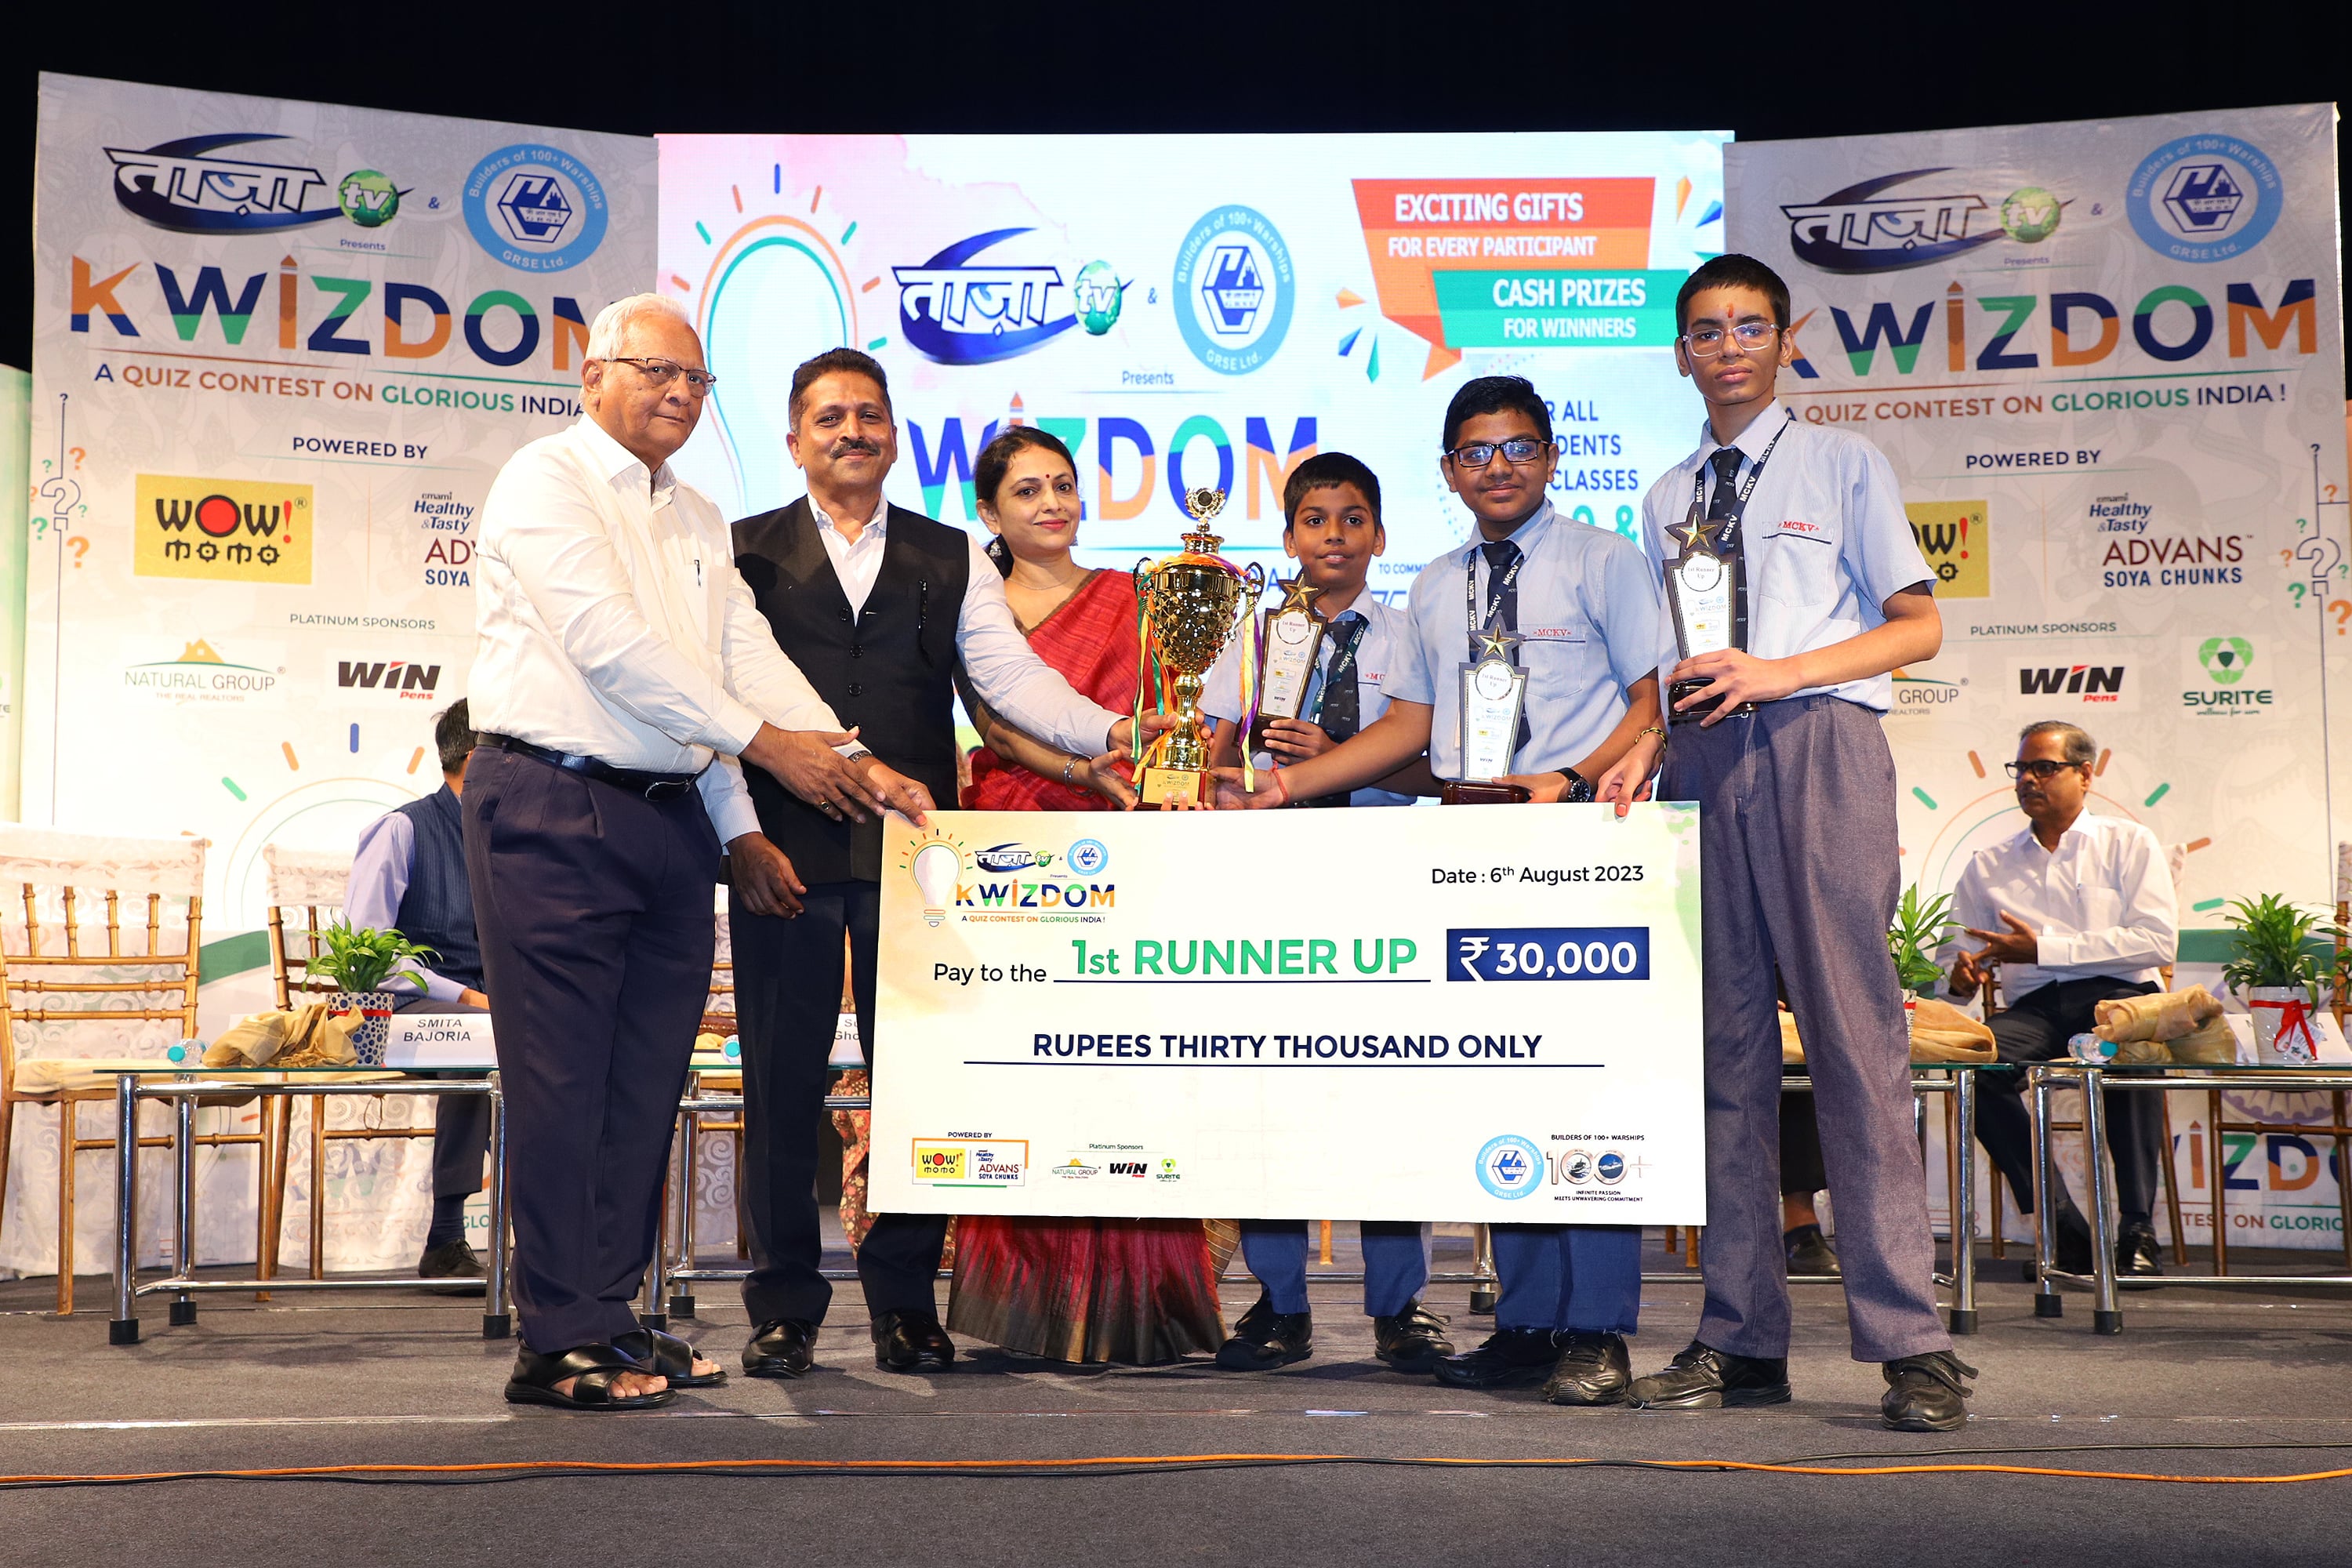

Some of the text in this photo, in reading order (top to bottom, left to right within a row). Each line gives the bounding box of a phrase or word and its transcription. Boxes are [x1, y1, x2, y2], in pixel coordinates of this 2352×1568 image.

[469, 150, 603, 209] Builders of 100+ Warships
[343, 181, 391, 211] tv
[428, 196, 440, 209] &
[1395, 192, 1584, 223] EXCITING GIFTS
[2006, 198, 2053, 227] tv
[2090, 203, 2103, 216] &
[339, 239, 386, 252] Presents
[1178, 227, 1211, 283] Builders
[1214, 214, 1225, 230] of
[1388, 236, 1597, 257] FOR EVERY PARTICIPANT
[2170, 244, 2209, 259] GRSE
[503, 250, 539, 269] GRSE
[2004, 255, 2049, 267] Presents
[1076, 278, 1117, 314] tv
[1147, 288, 1157, 304] &
[1492, 278, 1646, 307] CASH PRIZES
[1504, 318, 1636, 338] FOR WINNNERS
[1206, 350, 1237, 371] GRSE
[1122, 371, 1174, 385] Presents
[95, 364, 114, 383] A
[123, 365, 191, 388] QUIZ
[199, 371, 325, 397] CONTEST
[333, 382, 373, 401] ON
[382, 385, 514, 412] GLORIOUS
[1563, 400, 1599, 422] ALL
[1805, 404, 1867, 425] QUIZ
[1875, 397, 1995, 419] CONTEST
[2003, 395, 2042, 414] ON
[2052, 388, 2190, 412] GLORIOUS
[2198, 384, 2273, 406] INDIA
[293, 437, 428, 459] POWERED BY
[1555, 434, 1621, 456] DENTS
[1966, 450, 2101, 469] POWERED BY
[1551, 469, 1639, 491] CLASSES
[1740, 476, 1757, 502] MCKV
[422, 491, 452, 501] emami
[414, 500, 474, 519] Healthy
[2089, 503, 2152, 519] Healthy
[1721, 514, 1738, 542] MCKV
[2103, 535, 2244, 566] ADVANS
[425, 569, 470, 586] SOYA
[1379, 564, 1391, 575] TO
[1503, 564, 1519, 586] MCKV
[2104, 568, 2243, 587] SOYA CHUNKS
[1487, 593, 1501, 618] MCKV
[290, 614, 436, 630] PLATINUM SPONSORS
[1970, 622, 2117, 636] PLATINUM SPONSORS
[1353, 626, 1364, 645] MCKV
[1338, 651, 1352, 673] MCKV
[125, 670, 275, 692] NATURAL GROUP
[400, 691, 434, 701] Pens
[1899, 688, 1959, 705] GROUP
[2083, 694, 2118, 703] Pens
[2183, 690, 2273, 706] SURITE
[1432, 868, 1477, 884] Date
[1490, 866, 1515, 884] 6th
[1519, 867, 1590, 887] August
[1594, 865, 1645, 882] 2023
[934, 938, 1417, 986] Pay to the 1st RUNNER UP
[418, 1018, 463, 1029] SMITA
[403, 1031, 471, 1043] BAJORIA
[1033, 1034, 1543, 1058] RUPEES THIRTY THOUSAND ONLY
[978, 1163, 1019, 1173] ADVANS
[2234, 1214, 2264, 1229] ON
[2270, 1215, 2344, 1231] GLORIO
